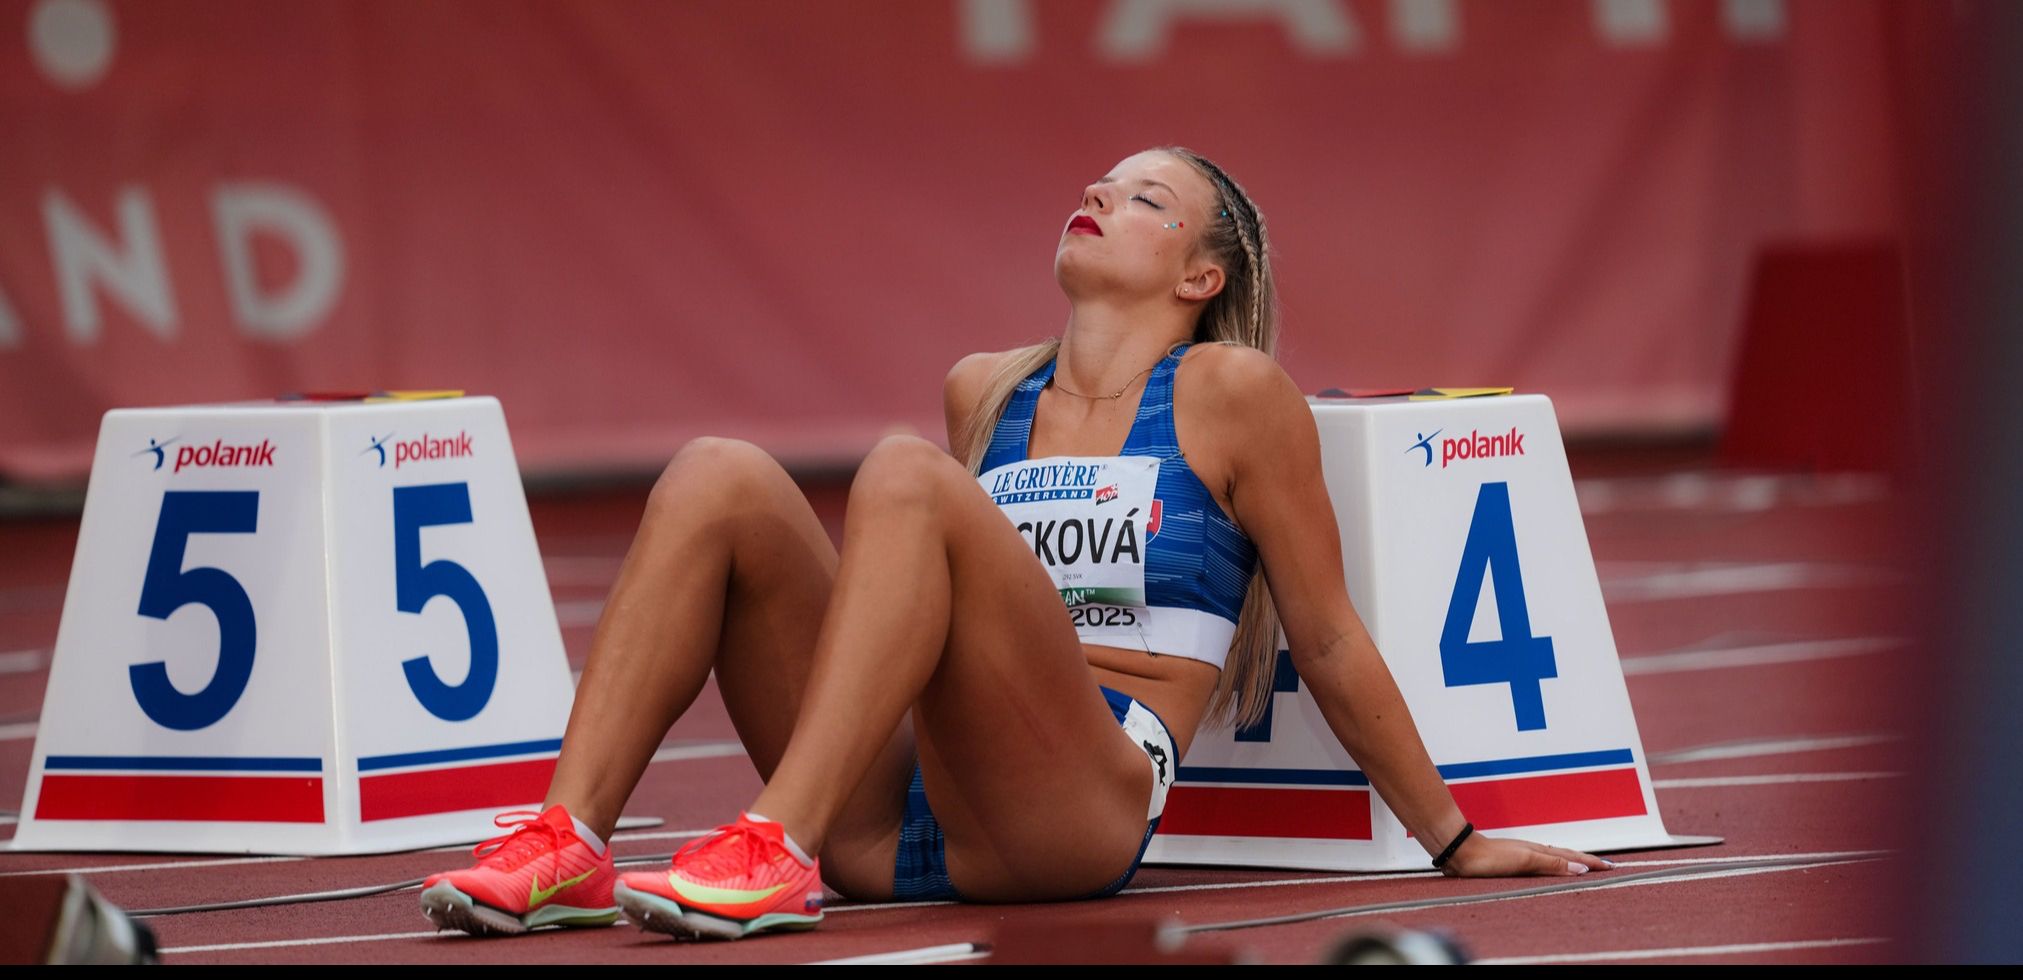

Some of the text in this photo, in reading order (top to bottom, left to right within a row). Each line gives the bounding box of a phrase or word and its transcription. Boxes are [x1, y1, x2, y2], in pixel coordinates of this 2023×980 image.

[0, 183, 345, 347] ND
[174, 439, 277, 474] polanik
[395, 430, 473, 469] polanik
[1442, 427, 1525, 468] polanik
[992, 471, 1014, 494] LE
[129, 491, 259, 731] 5
[393, 482, 498, 722] 5
[1069, 607, 1136, 627] 2025
[1439, 481, 1558, 732] 4
